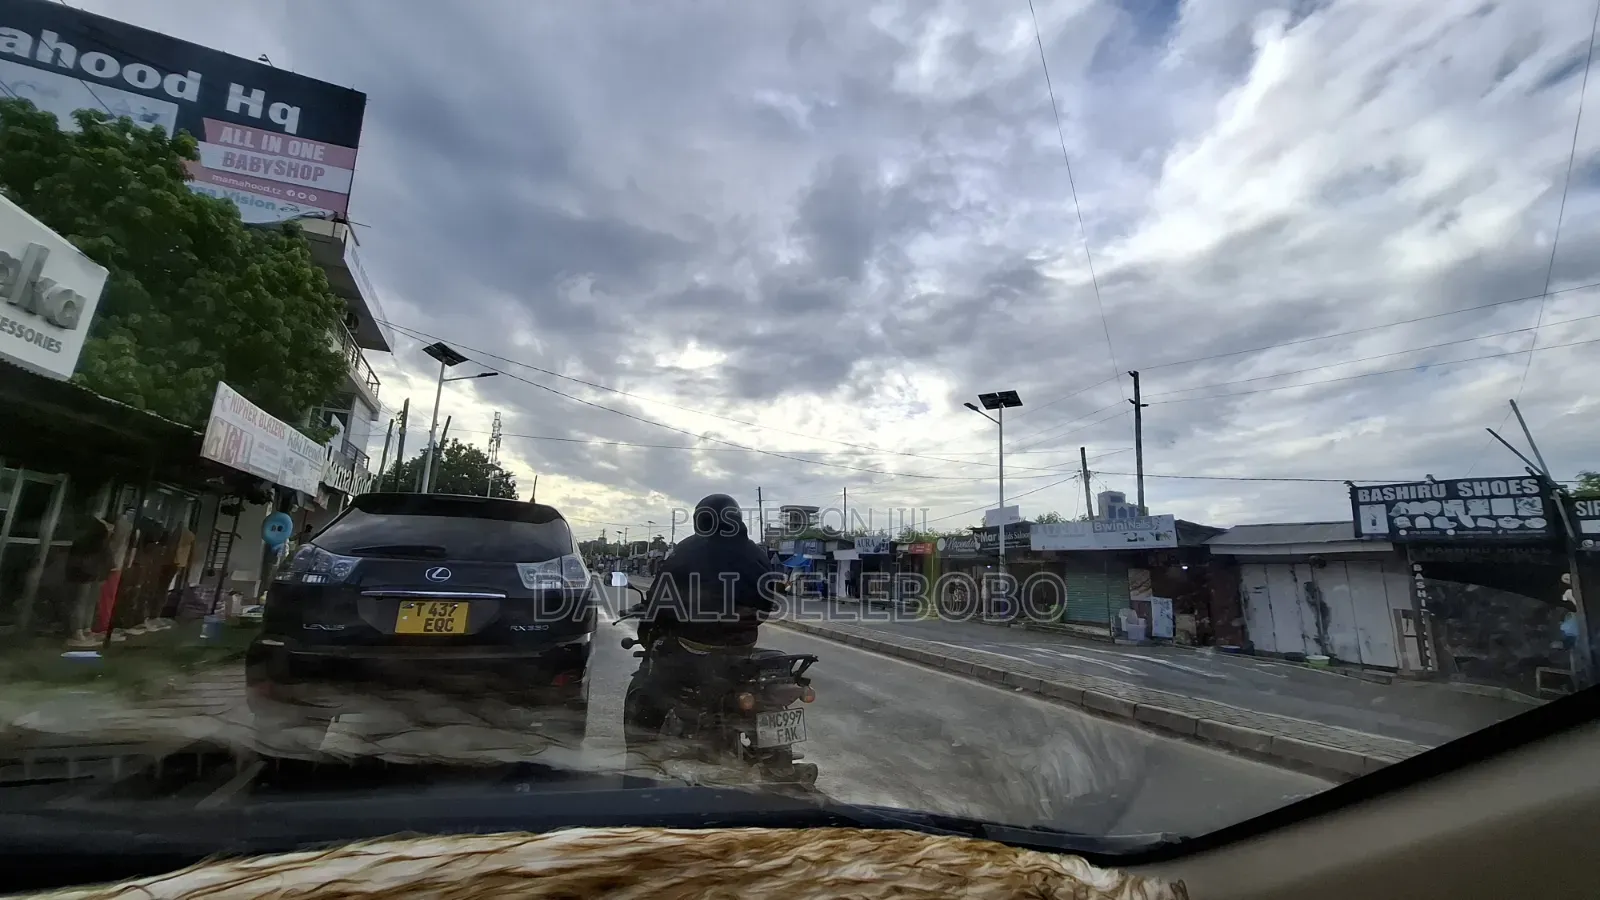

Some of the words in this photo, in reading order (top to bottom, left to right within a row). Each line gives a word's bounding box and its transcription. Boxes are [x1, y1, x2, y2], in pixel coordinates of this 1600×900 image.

[225, 82, 301, 135] Hq
[219, 126, 254, 148] ALL
[261, 134, 283, 153] IN
[288, 140, 325, 162] ONE
[221, 151, 325, 182] BABYSHOP
[212, 174, 282, 195] mamahood.tz
[1357, 483, 1447, 502] BASHIRU
[1456, 478, 1540, 498] SHOES
[857, 538, 875, 548] AURA
[416, 602, 426, 617] T
[428, 602, 458, 617] 437
[423, 618, 455, 633] EQC
